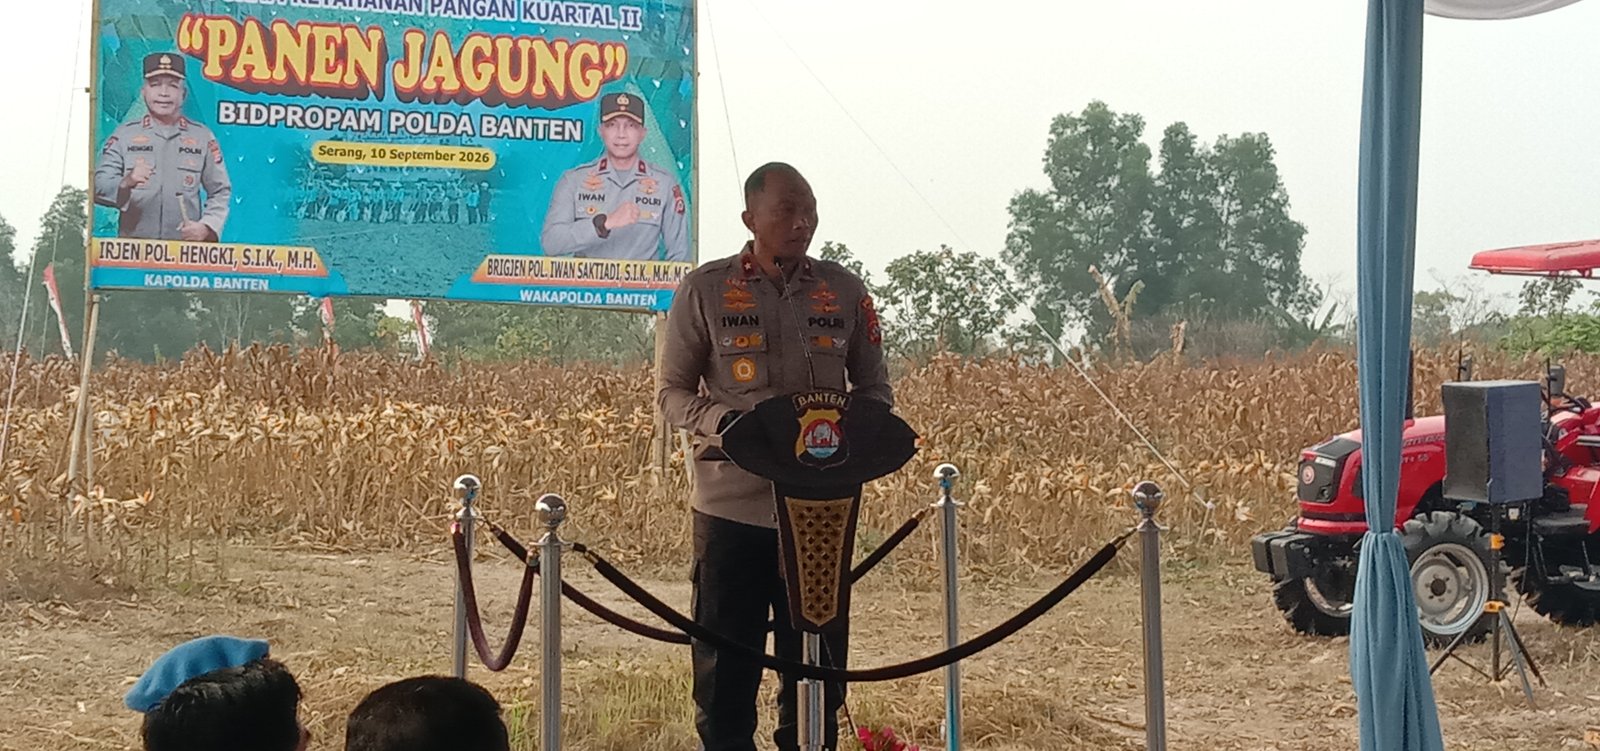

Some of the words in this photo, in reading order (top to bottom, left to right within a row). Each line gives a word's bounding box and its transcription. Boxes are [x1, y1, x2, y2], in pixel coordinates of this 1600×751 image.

[431, 0, 519, 20] PANGAN
[525, 2, 614, 26] KUARTAL
[622, 9, 641, 28] II
[218, 102, 382, 132] BIDPROPAM
[389, 113, 474, 137] POLDA
[480, 118, 583, 142] BANTEN
[179, 146, 202, 155] POLRI
[318, 145, 367, 160] Serang,
[371, 147, 387, 159] 10
[389, 148, 456, 163] September
[458, 151, 490, 163] 2026
[578, 192, 606, 202] IWAN
[635, 196, 662, 206] POLRI
[99, 240, 141, 261] IRJEN
[144, 244, 175, 263] POL.
[180, 245, 239, 268] HENGKI,
[287, 251, 317, 269] M.H.
[486, 258, 527, 277] BRIGJEN
[528, 261, 548, 279] POL.
[549, 262, 576, 280] IWAN
[577, 262, 622, 284] SAKTIADI,
[144, 273, 210, 289] KAPOLDA
[213, 276, 270, 290] BANTEN
[520, 289, 603, 305] WAKAPOLDA
[606, 293, 657, 307] BANTEN
[721, 315, 760, 328] IWAN
[807, 316, 845, 329] POLRI
[797, 393, 847, 406] BANTEN
